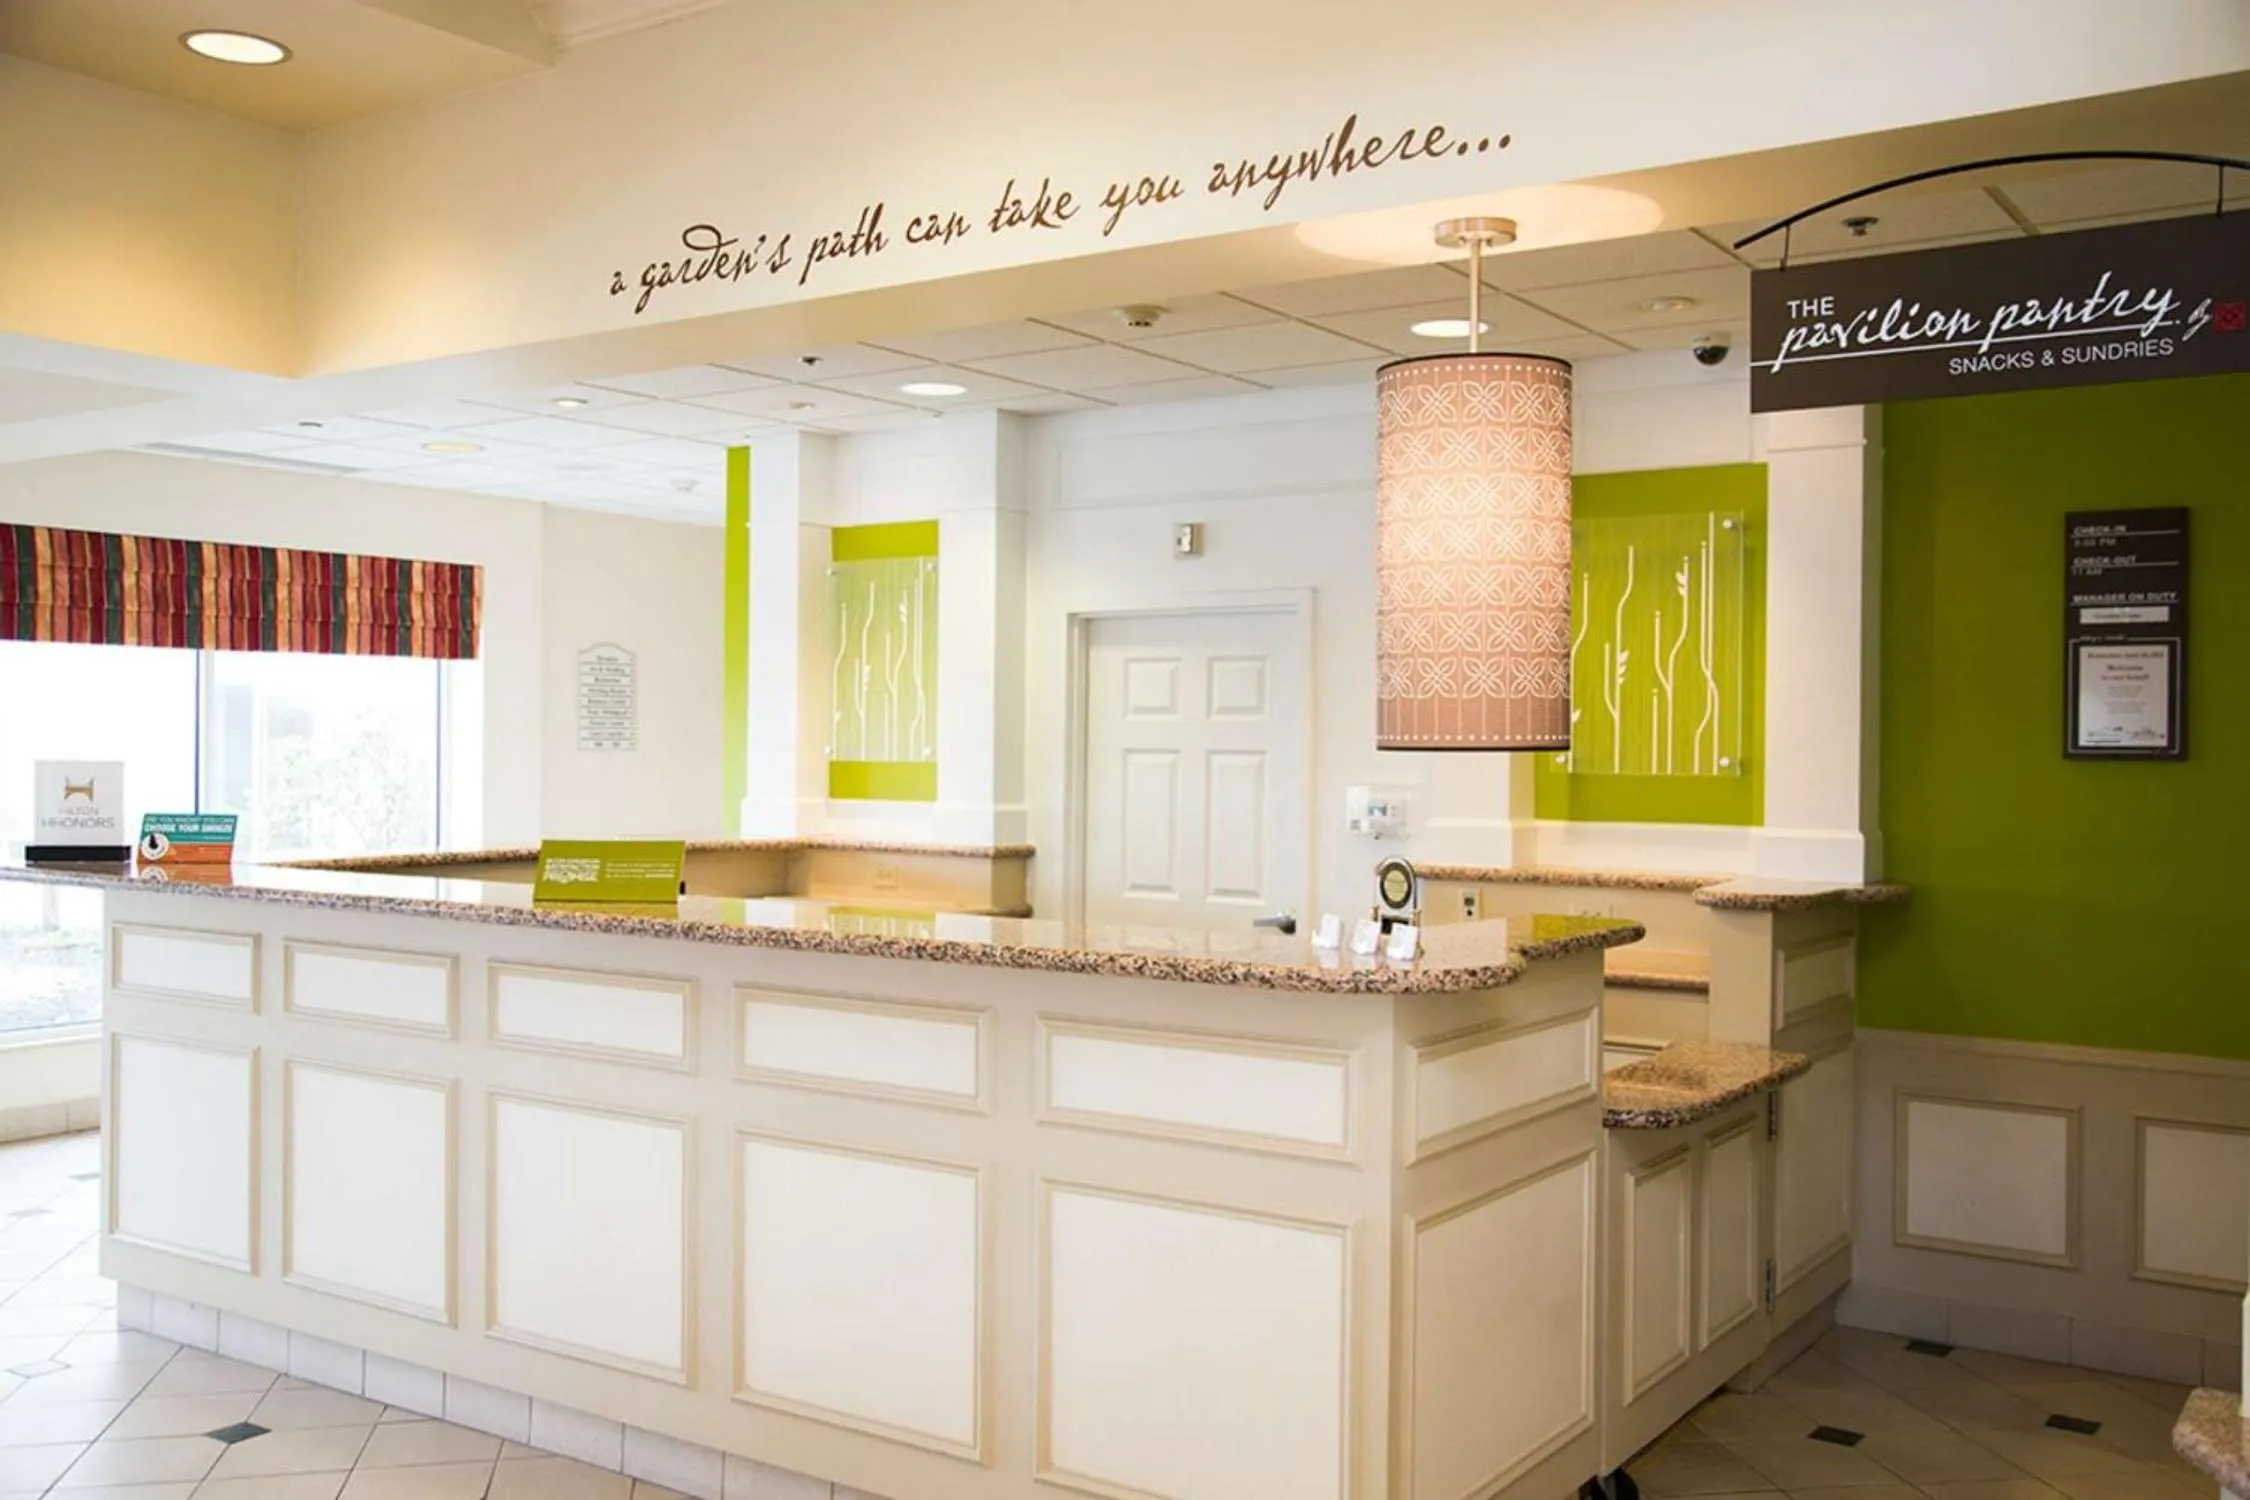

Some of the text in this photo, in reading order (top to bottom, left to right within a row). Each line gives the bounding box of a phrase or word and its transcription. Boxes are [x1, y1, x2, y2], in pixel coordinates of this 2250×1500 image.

[610, 271, 627, 297] a
[634, 223, 793, 315] garden's
[799, 202, 889, 286] path
[905, 210, 972, 247] can
[987, 177, 1081, 233] take
[1099, 175, 1185, 237] you
[1786, 295, 1836, 321] THE
[1770, 298, 1981, 374] pavilion
[1948, 337, 2175, 377] SNACKS & SUNDRIES
[2073, 593, 2126, 603] MANAGER
[2146, 591, 2178, 602] DUTY
